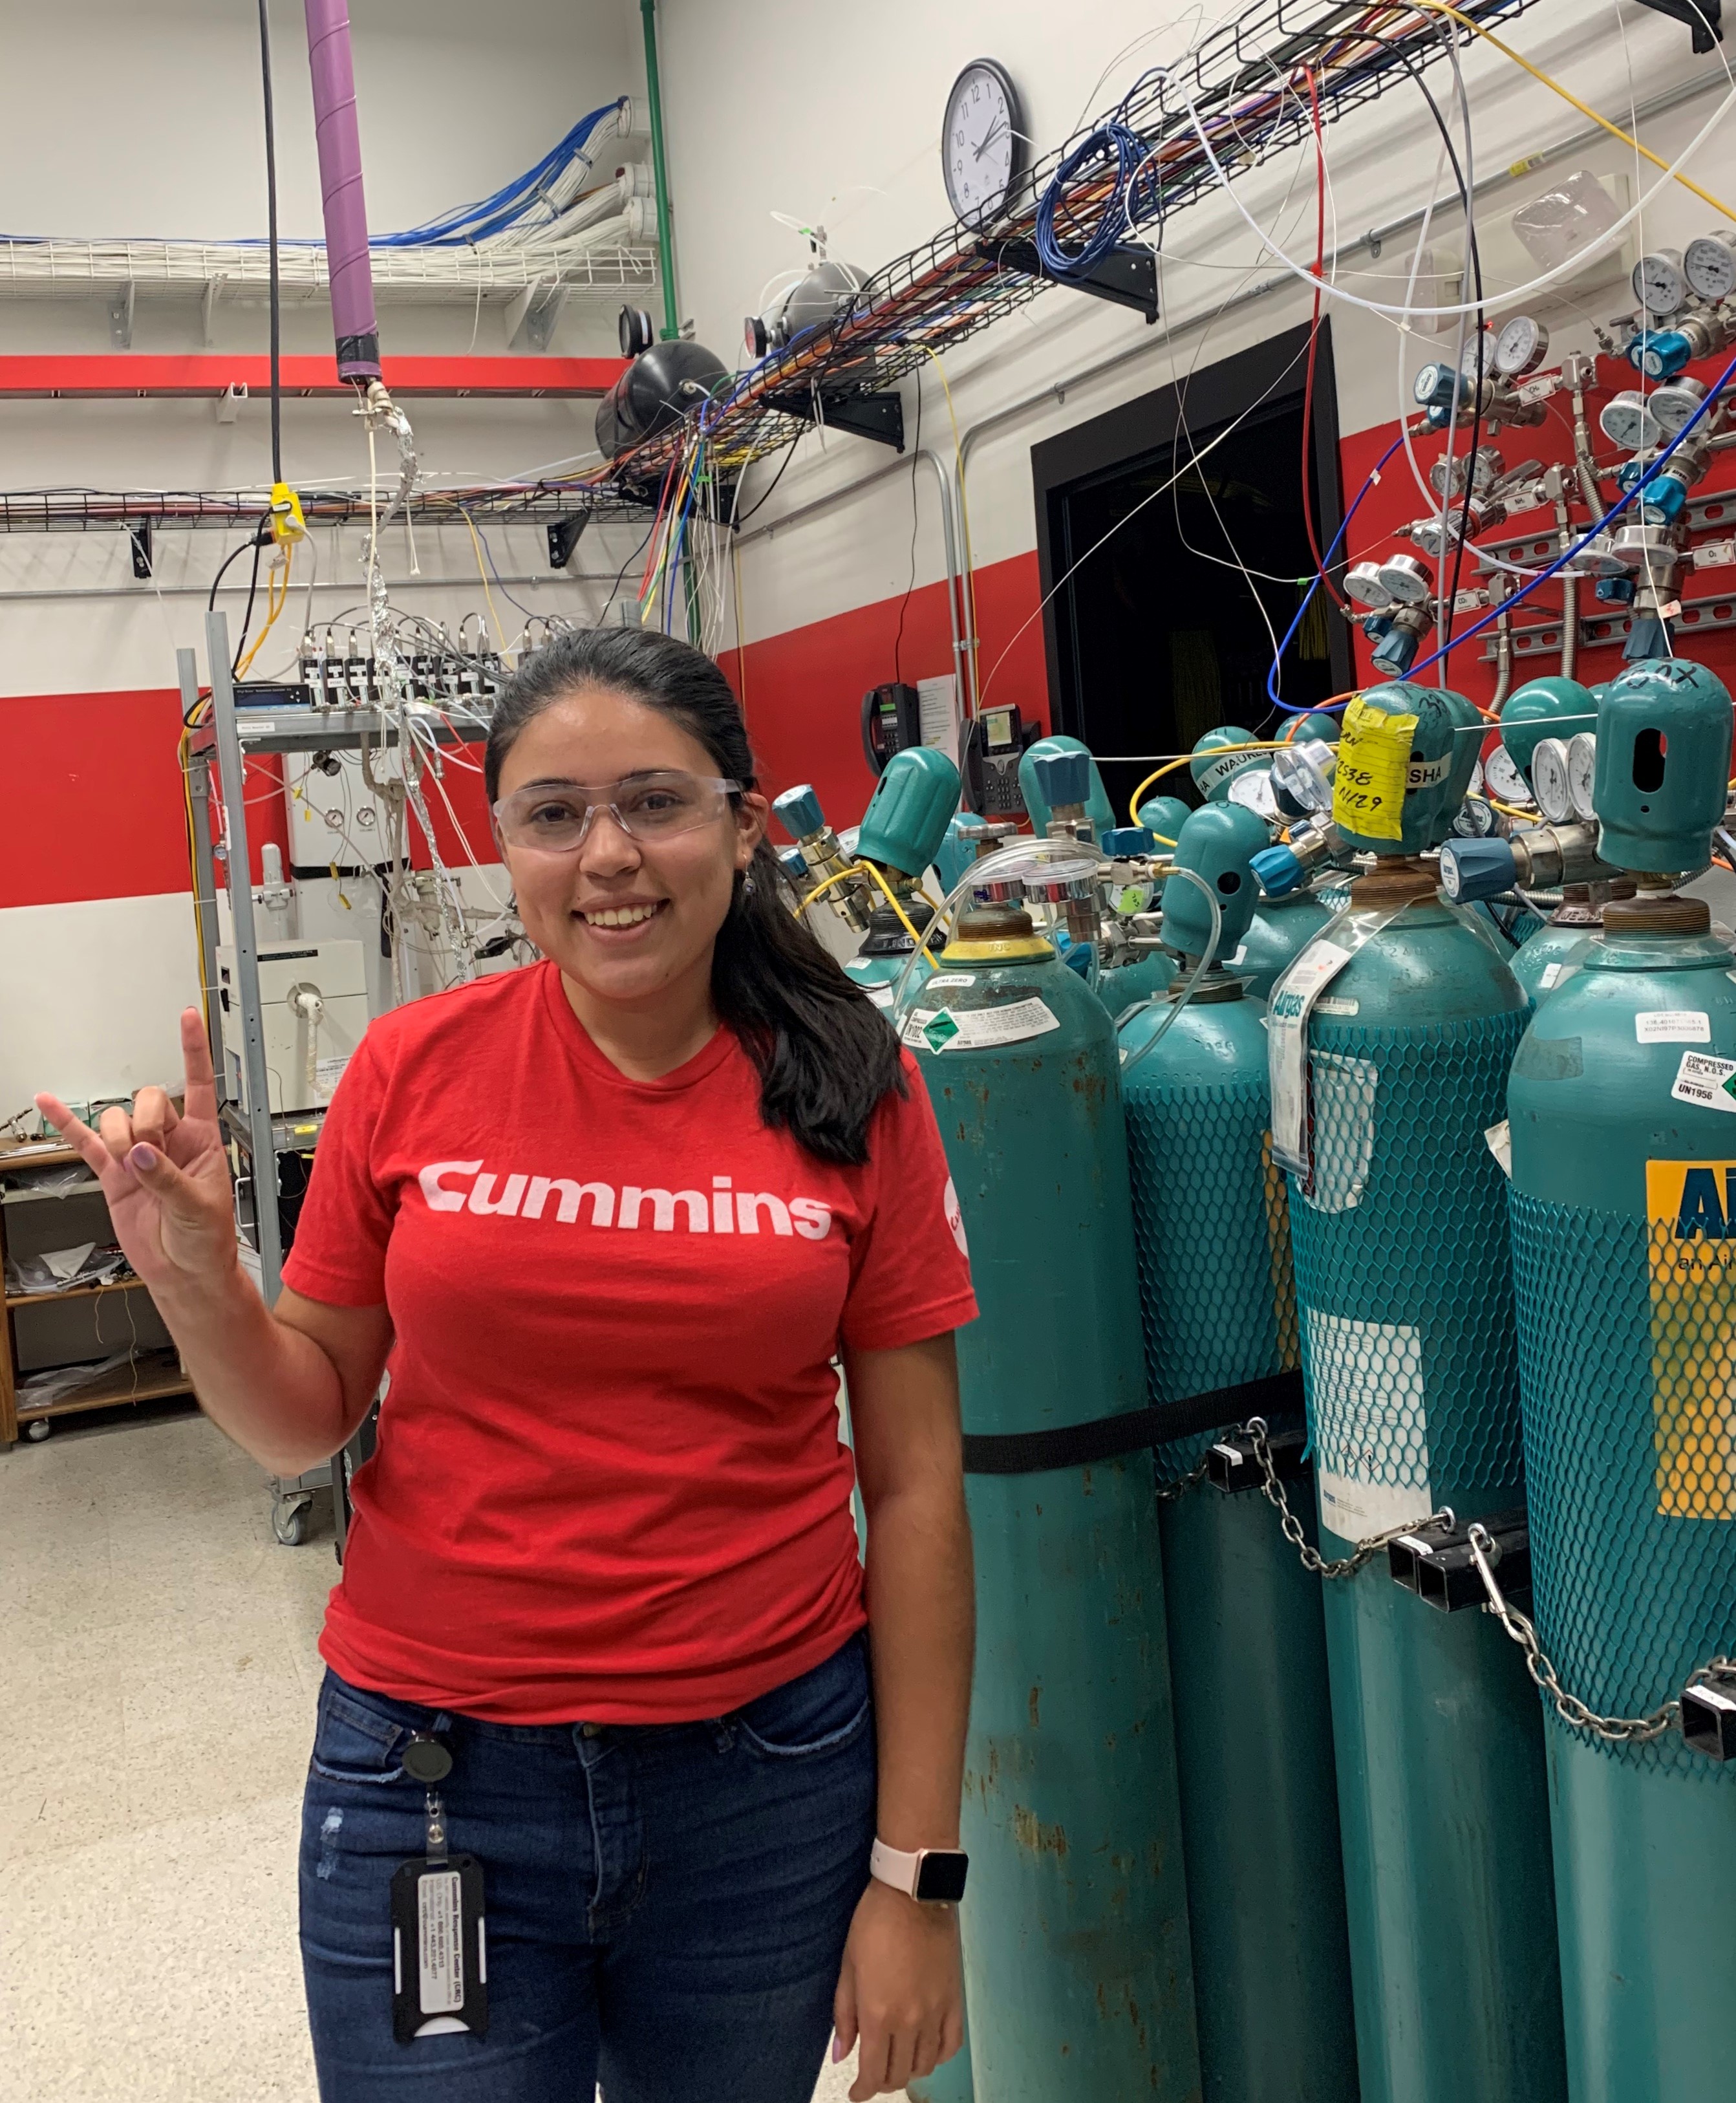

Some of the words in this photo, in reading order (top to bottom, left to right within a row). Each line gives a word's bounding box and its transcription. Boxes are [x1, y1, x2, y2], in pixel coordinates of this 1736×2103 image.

[971, 85, 980, 104] 12
[987, 83, 991, 99] 1
[961, 102, 969, 120] 11
[998, 96, 1004, 114] 2
[956, 130, 964, 149] 10
[1005, 151, 1009, 166] 4
[957, 160, 963, 175] 9
[963, 182, 969, 199] 8
[1409, 766, 1441, 783] SHA
[1273, 991, 1305, 1019] Airgas
[1688, 1055, 1733, 1071] COMPRESSED
[1704, 1066, 1725, 1076] N.O.S.
[1678, 1084, 1713, 1100] UN1956
[418, 1159, 832, 1240] Cummins
[453, 1981, 462, 2003] (CRC)
